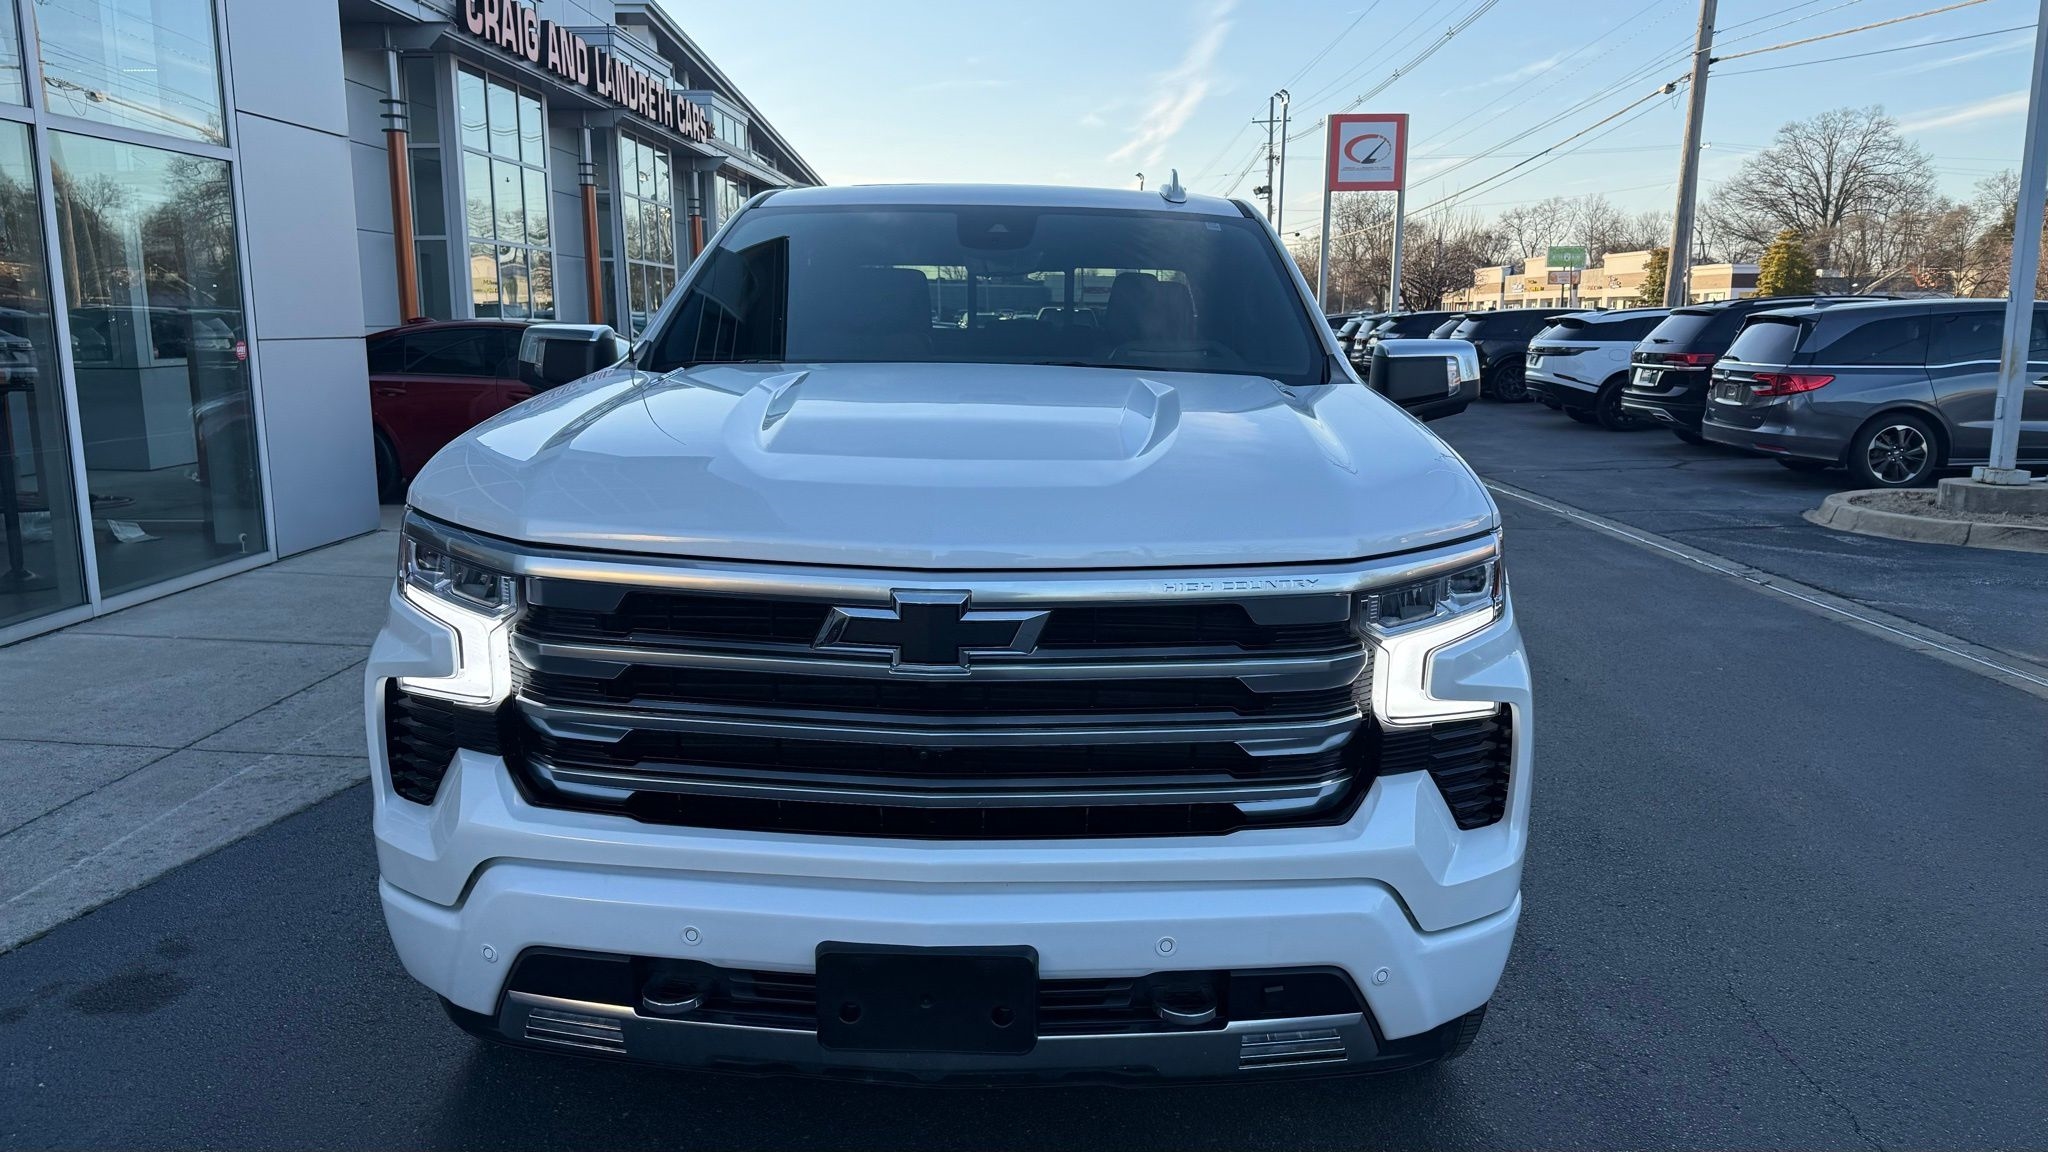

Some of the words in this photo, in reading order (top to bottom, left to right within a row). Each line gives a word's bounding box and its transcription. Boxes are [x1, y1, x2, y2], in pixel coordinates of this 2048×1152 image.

[466, 0, 539, 63] CRAIG
[548, 20, 589, 86] AND
[595, 46, 673, 128] LANDRETH
[677, 94, 707, 144] CARS
[1163, 581, 1213, 592] HIGH
[1222, 578, 1319, 590] COUNTRY
